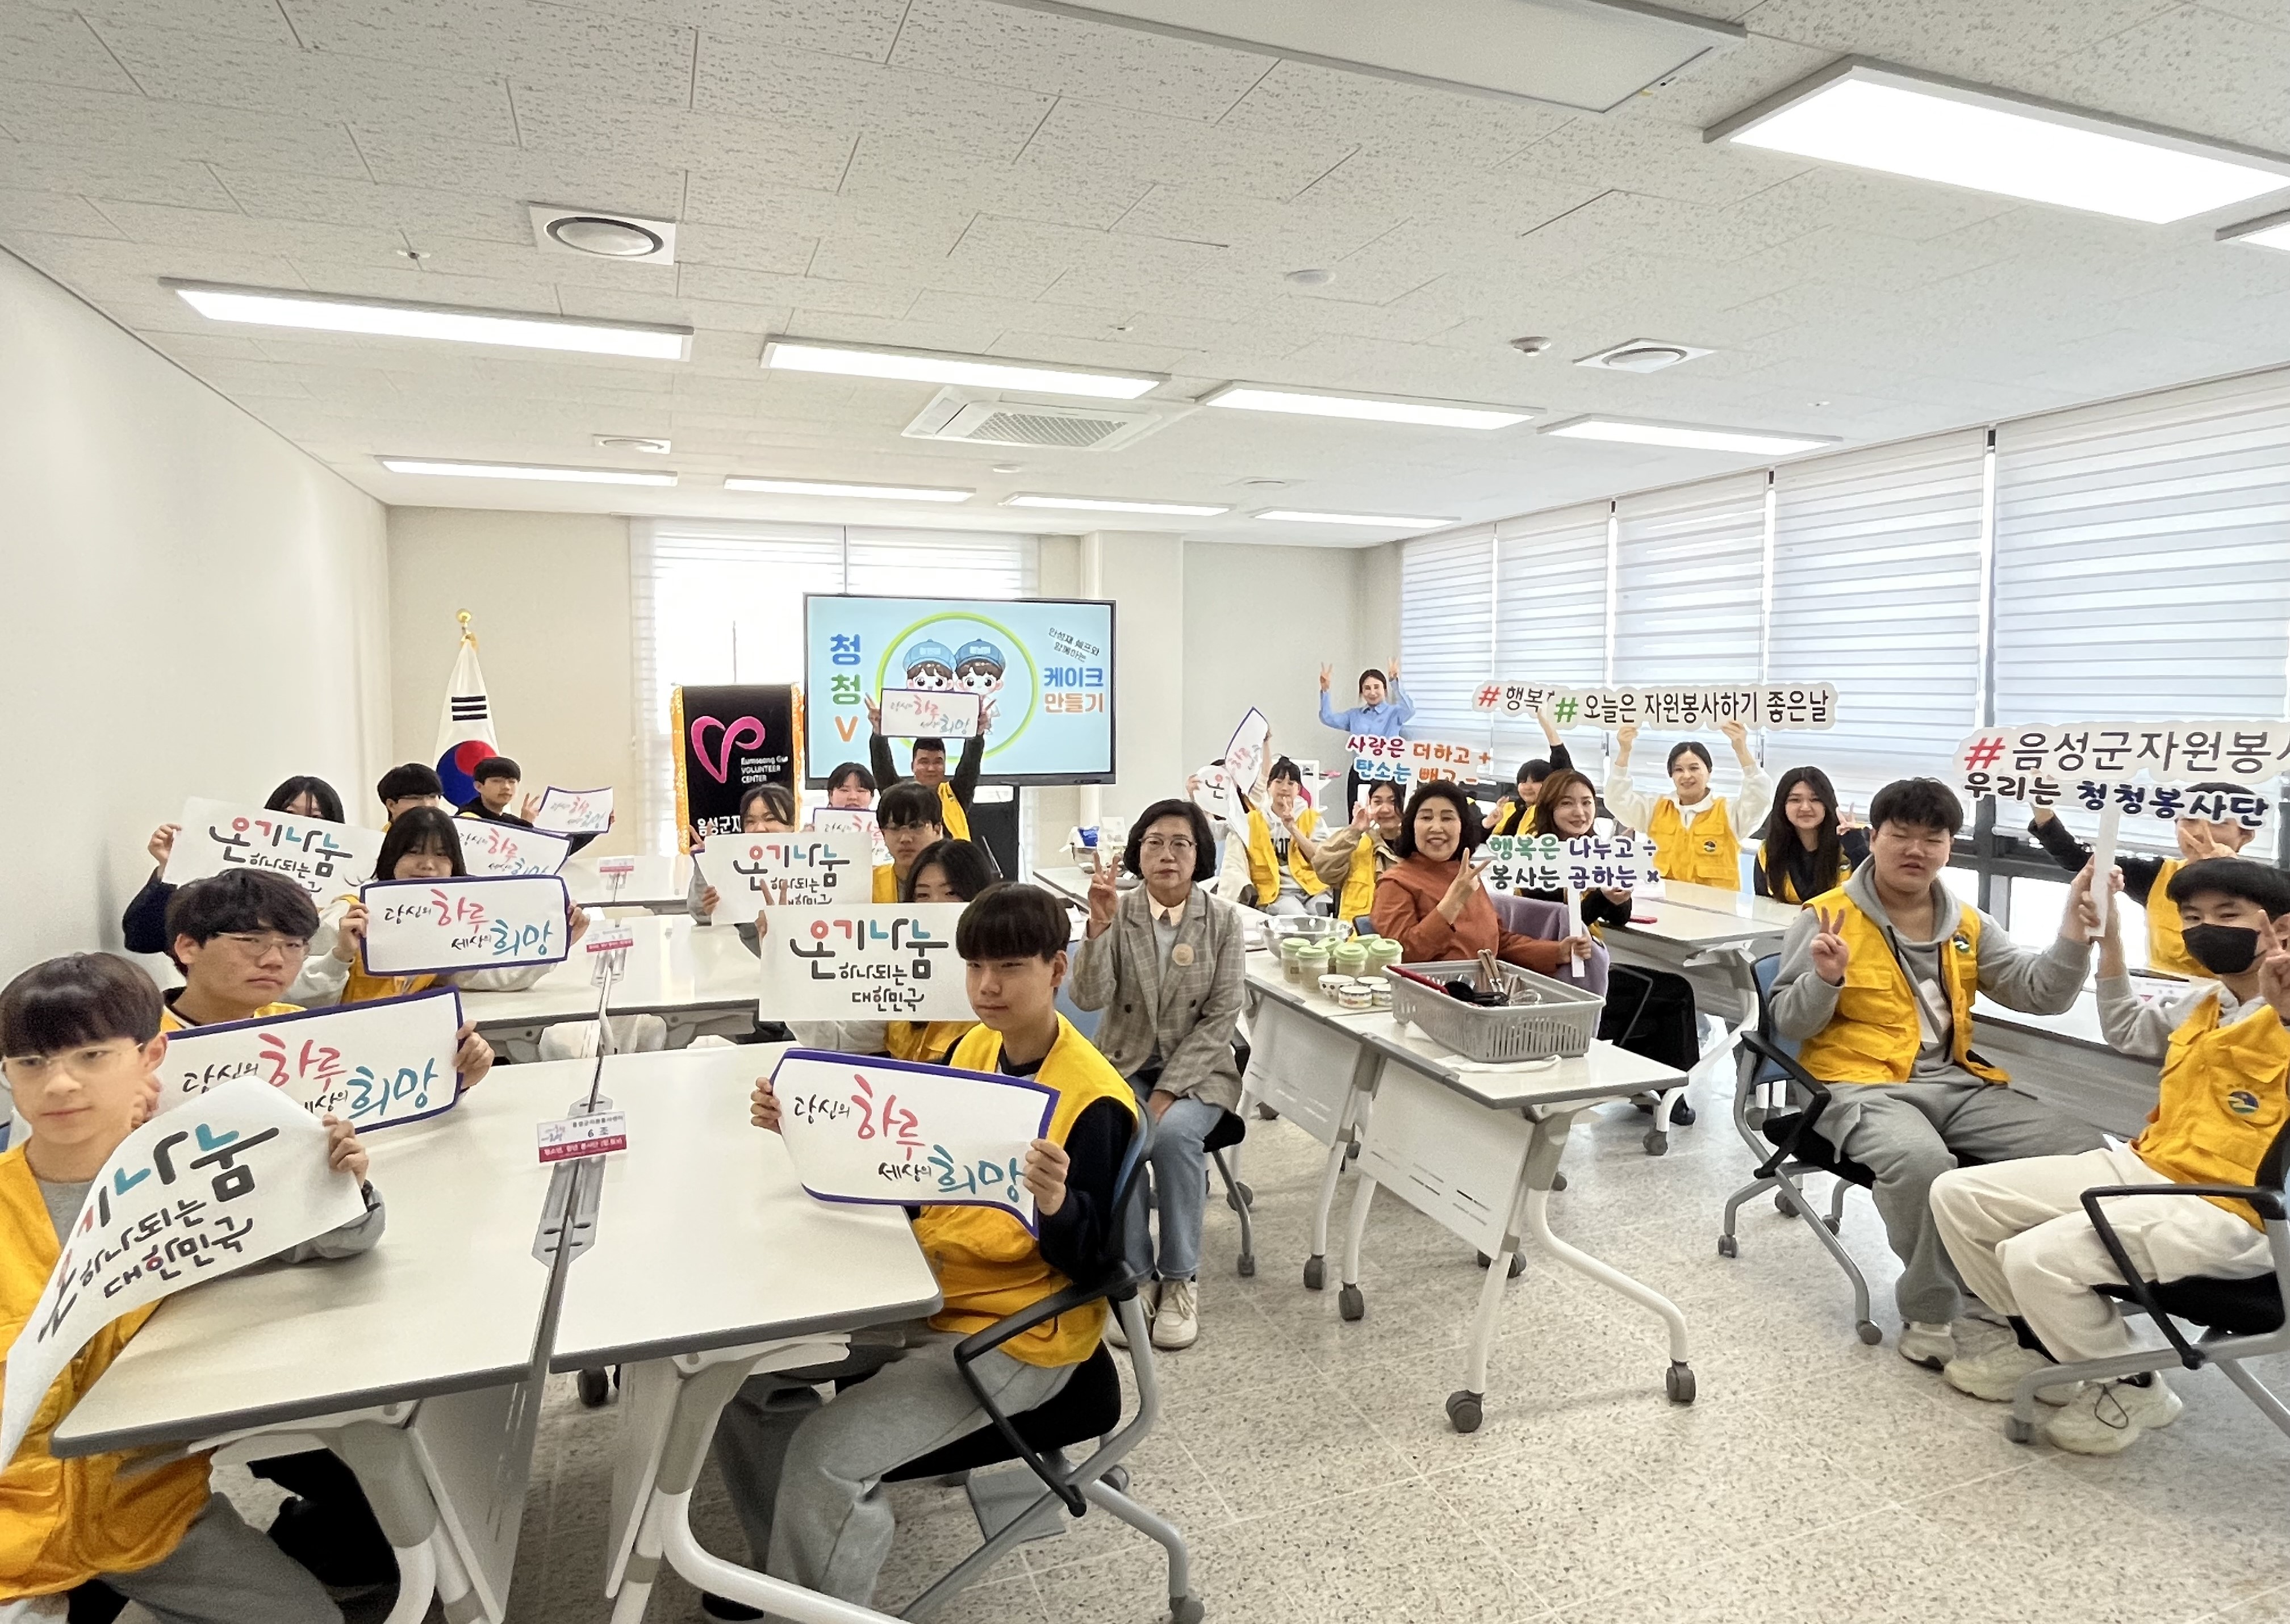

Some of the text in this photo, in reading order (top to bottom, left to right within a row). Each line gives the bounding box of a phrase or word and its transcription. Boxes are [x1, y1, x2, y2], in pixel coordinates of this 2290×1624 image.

[1044, 667, 1104, 688] 케이크
[1044, 692, 1104, 714] 만들기
[1644, 691, 1758, 723] 자원봉사하기
[1767, 689, 1829, 723] 좋은날
[1347, 736, 1405, 759] 사랑은
[1413, 743, 1470, 764] 더하고
[1963, 730, 2290, 774] #음성군자원봉
[741, 765, 781, 774] VOLUNTEER
[1356, 759, 1412, 782] 탄소는
[1964, 772, 2270, 827] 우리는 청청봉사단
[208, 816, 353, 878] 온기나눔
[488, 827, 518, 865] 하루
[1489, 836, 1561, 861] 행복은
[1569, 838, 1635, 860] 나누고
[249, 852, 311, 879] 하나되는
[733, 843, 851, 891] 온기나눔
[1490, 864, 1561, 890] 봉사는
[1568, 865, 1637, 890] 곱하는
[384, 889, 489, 934] 당신의 하루
[451, 919, 553, 956] 세상의 희망
[789, 918, 949, 981] 온기나눔
[838, 961, 908, 986] 하나되는
[851, 985, 925, 1012] 대한민국
[258, 1033, 348, 1093] 하루
[346, 1057, 438, 1119] 희망
[587, 1129, 595, 1138] 6
[794, 1074, 926, 1161] 당신의 하루
[877, 1144, 1026, 1203] 세상의 희망
[78, 1199, 207, 1287] 하나되는
[103, 1216, 254, 1299] 대한민국
